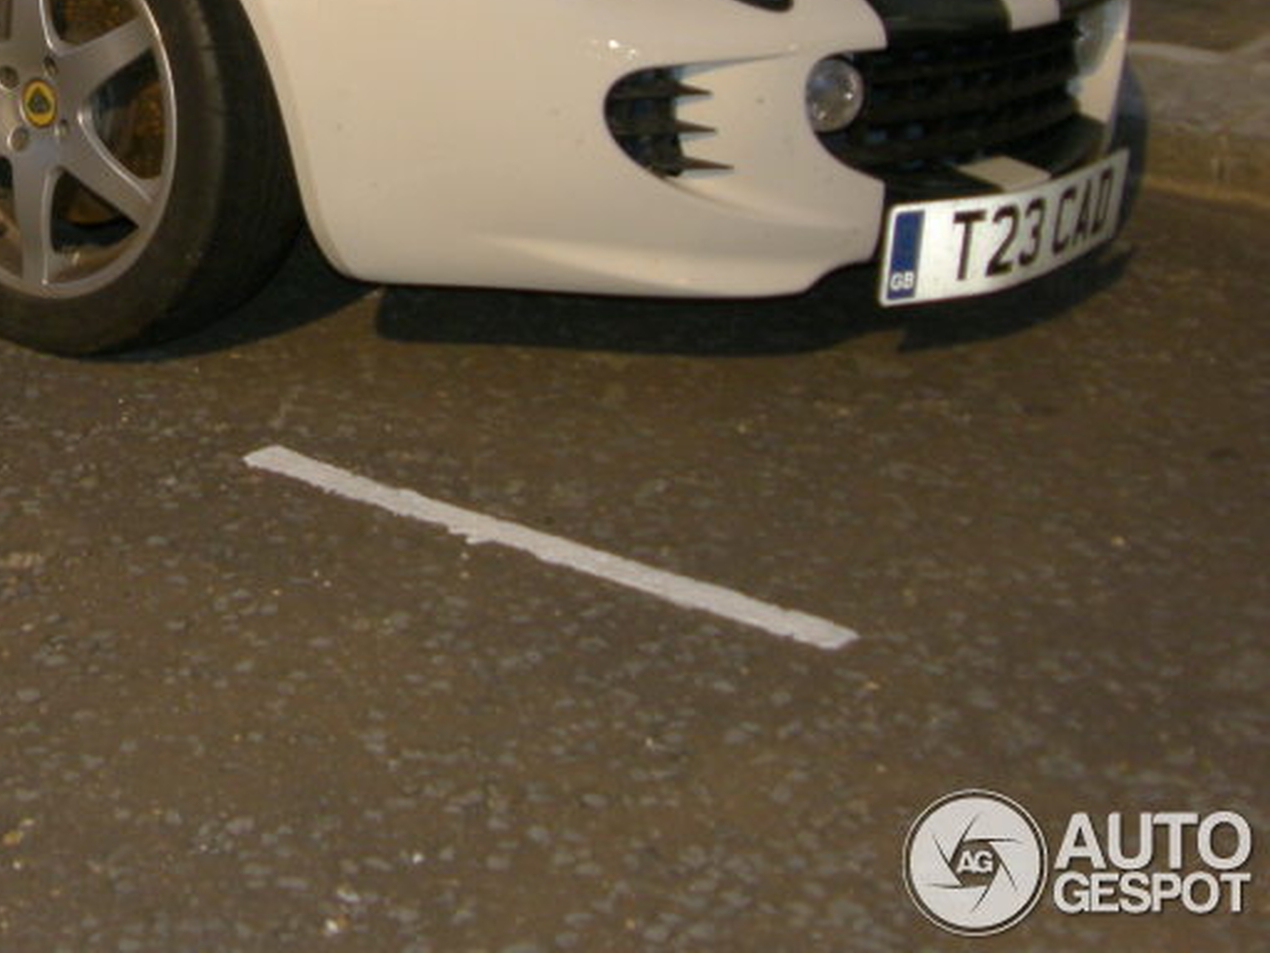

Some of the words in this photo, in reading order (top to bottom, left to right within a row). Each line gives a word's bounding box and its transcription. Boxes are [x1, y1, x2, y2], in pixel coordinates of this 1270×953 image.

[952, 196, 1046, 281] T23
[1051, 166, 1114, 255] CAD
[889, 271, 916, 291] GB
